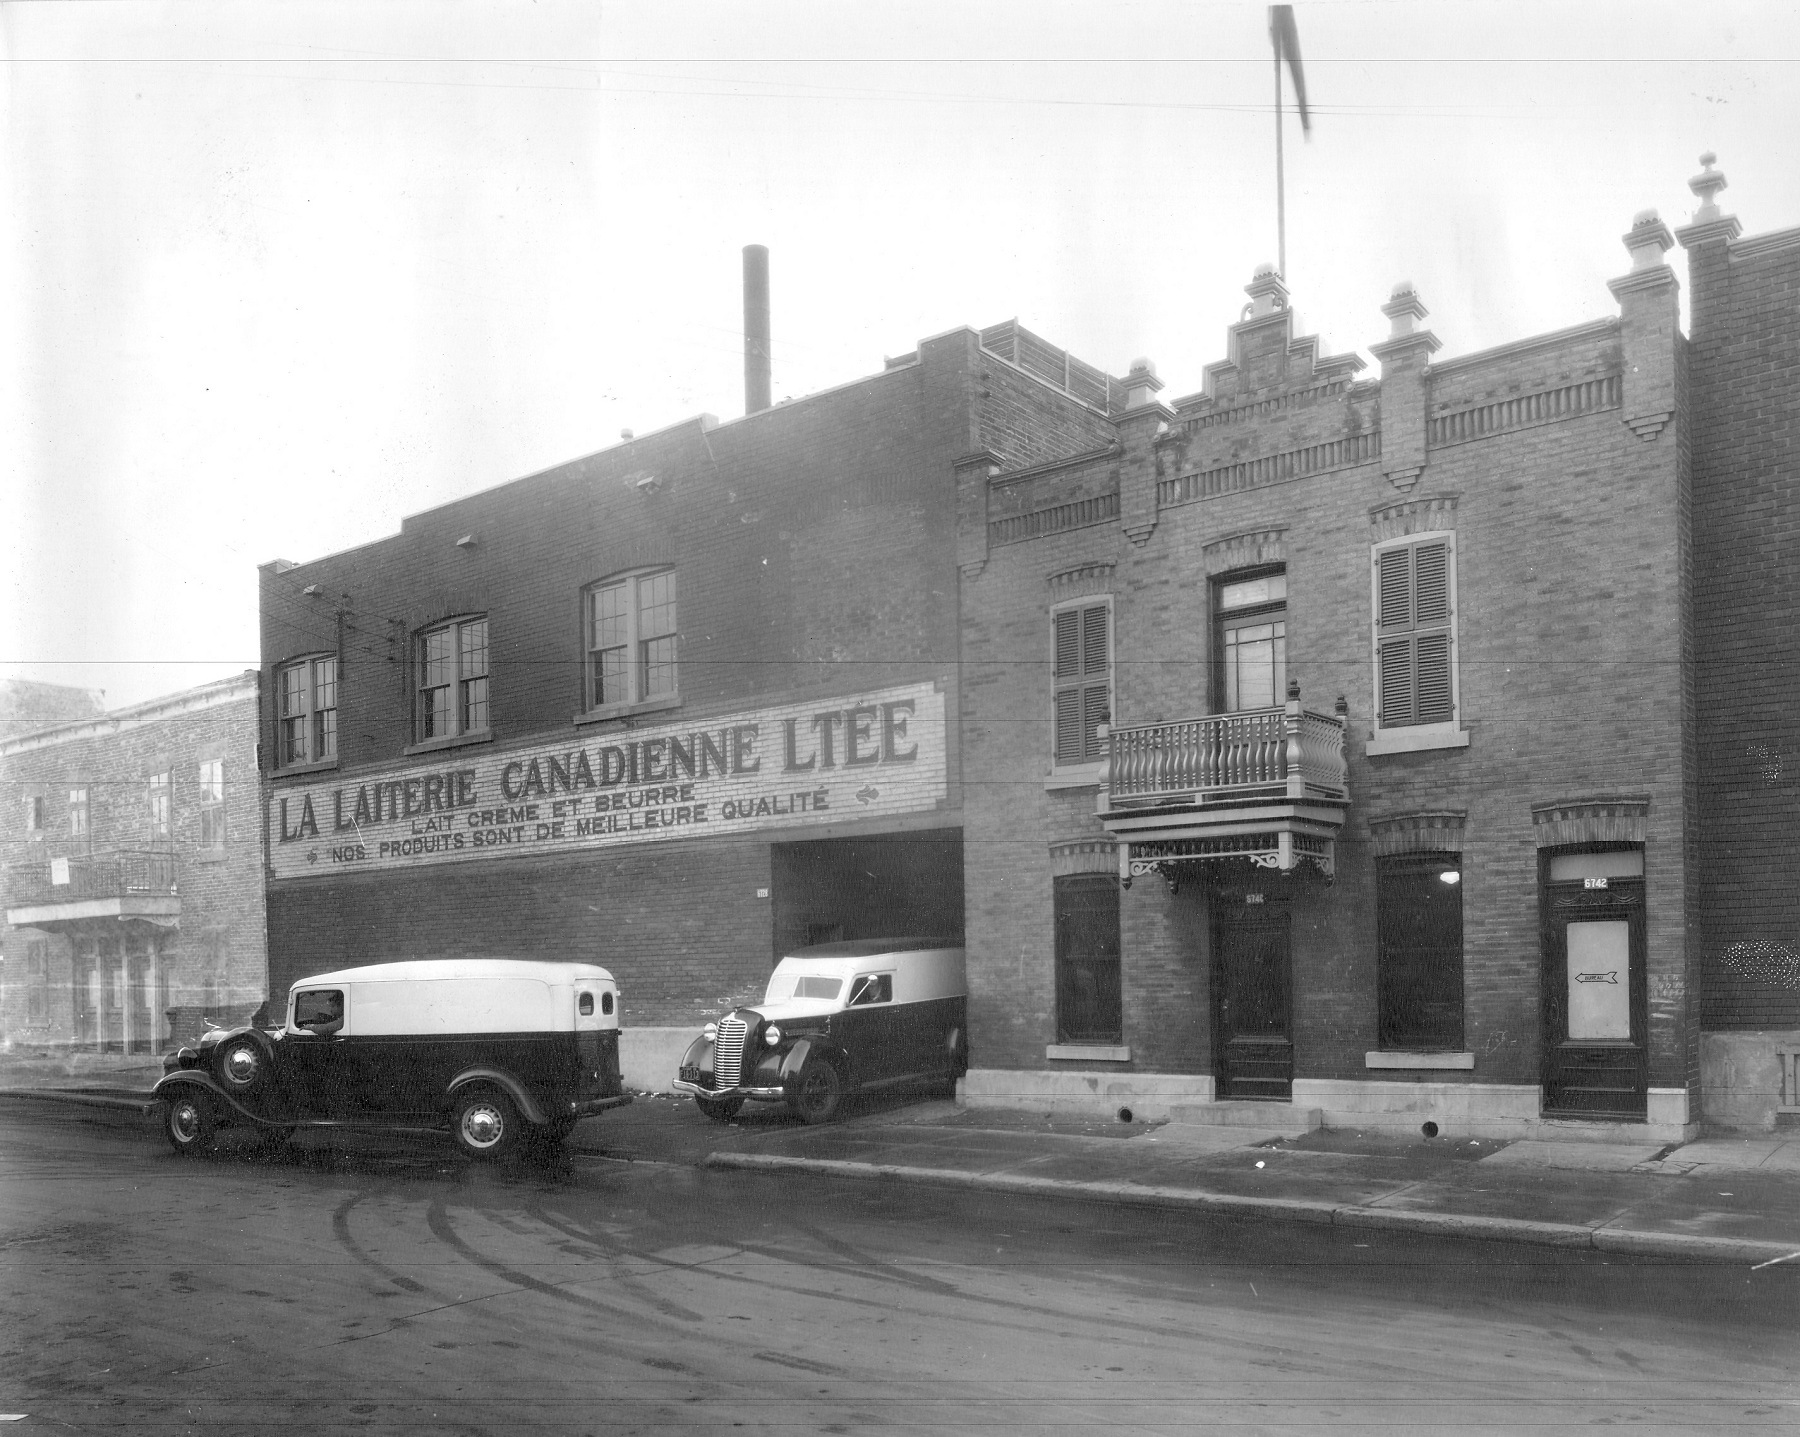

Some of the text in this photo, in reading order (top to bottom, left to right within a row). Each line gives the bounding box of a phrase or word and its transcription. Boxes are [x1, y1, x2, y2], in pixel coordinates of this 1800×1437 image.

[279, 792, 320, 842] LA
[333, 769, 478, 832] LAITERIE
[501, 722, 761, 803] CANADIENNE
[411, 815, 455, 835] LAIT
[552, 797, 582, 818] ET
[595, 783, 695, 812] BEURRE
[332, 785, 830, 863] NOS PRODUITS SONT DE MEILLEURE QUALITÉ
[1584, 878, 1607, 888] 6742
